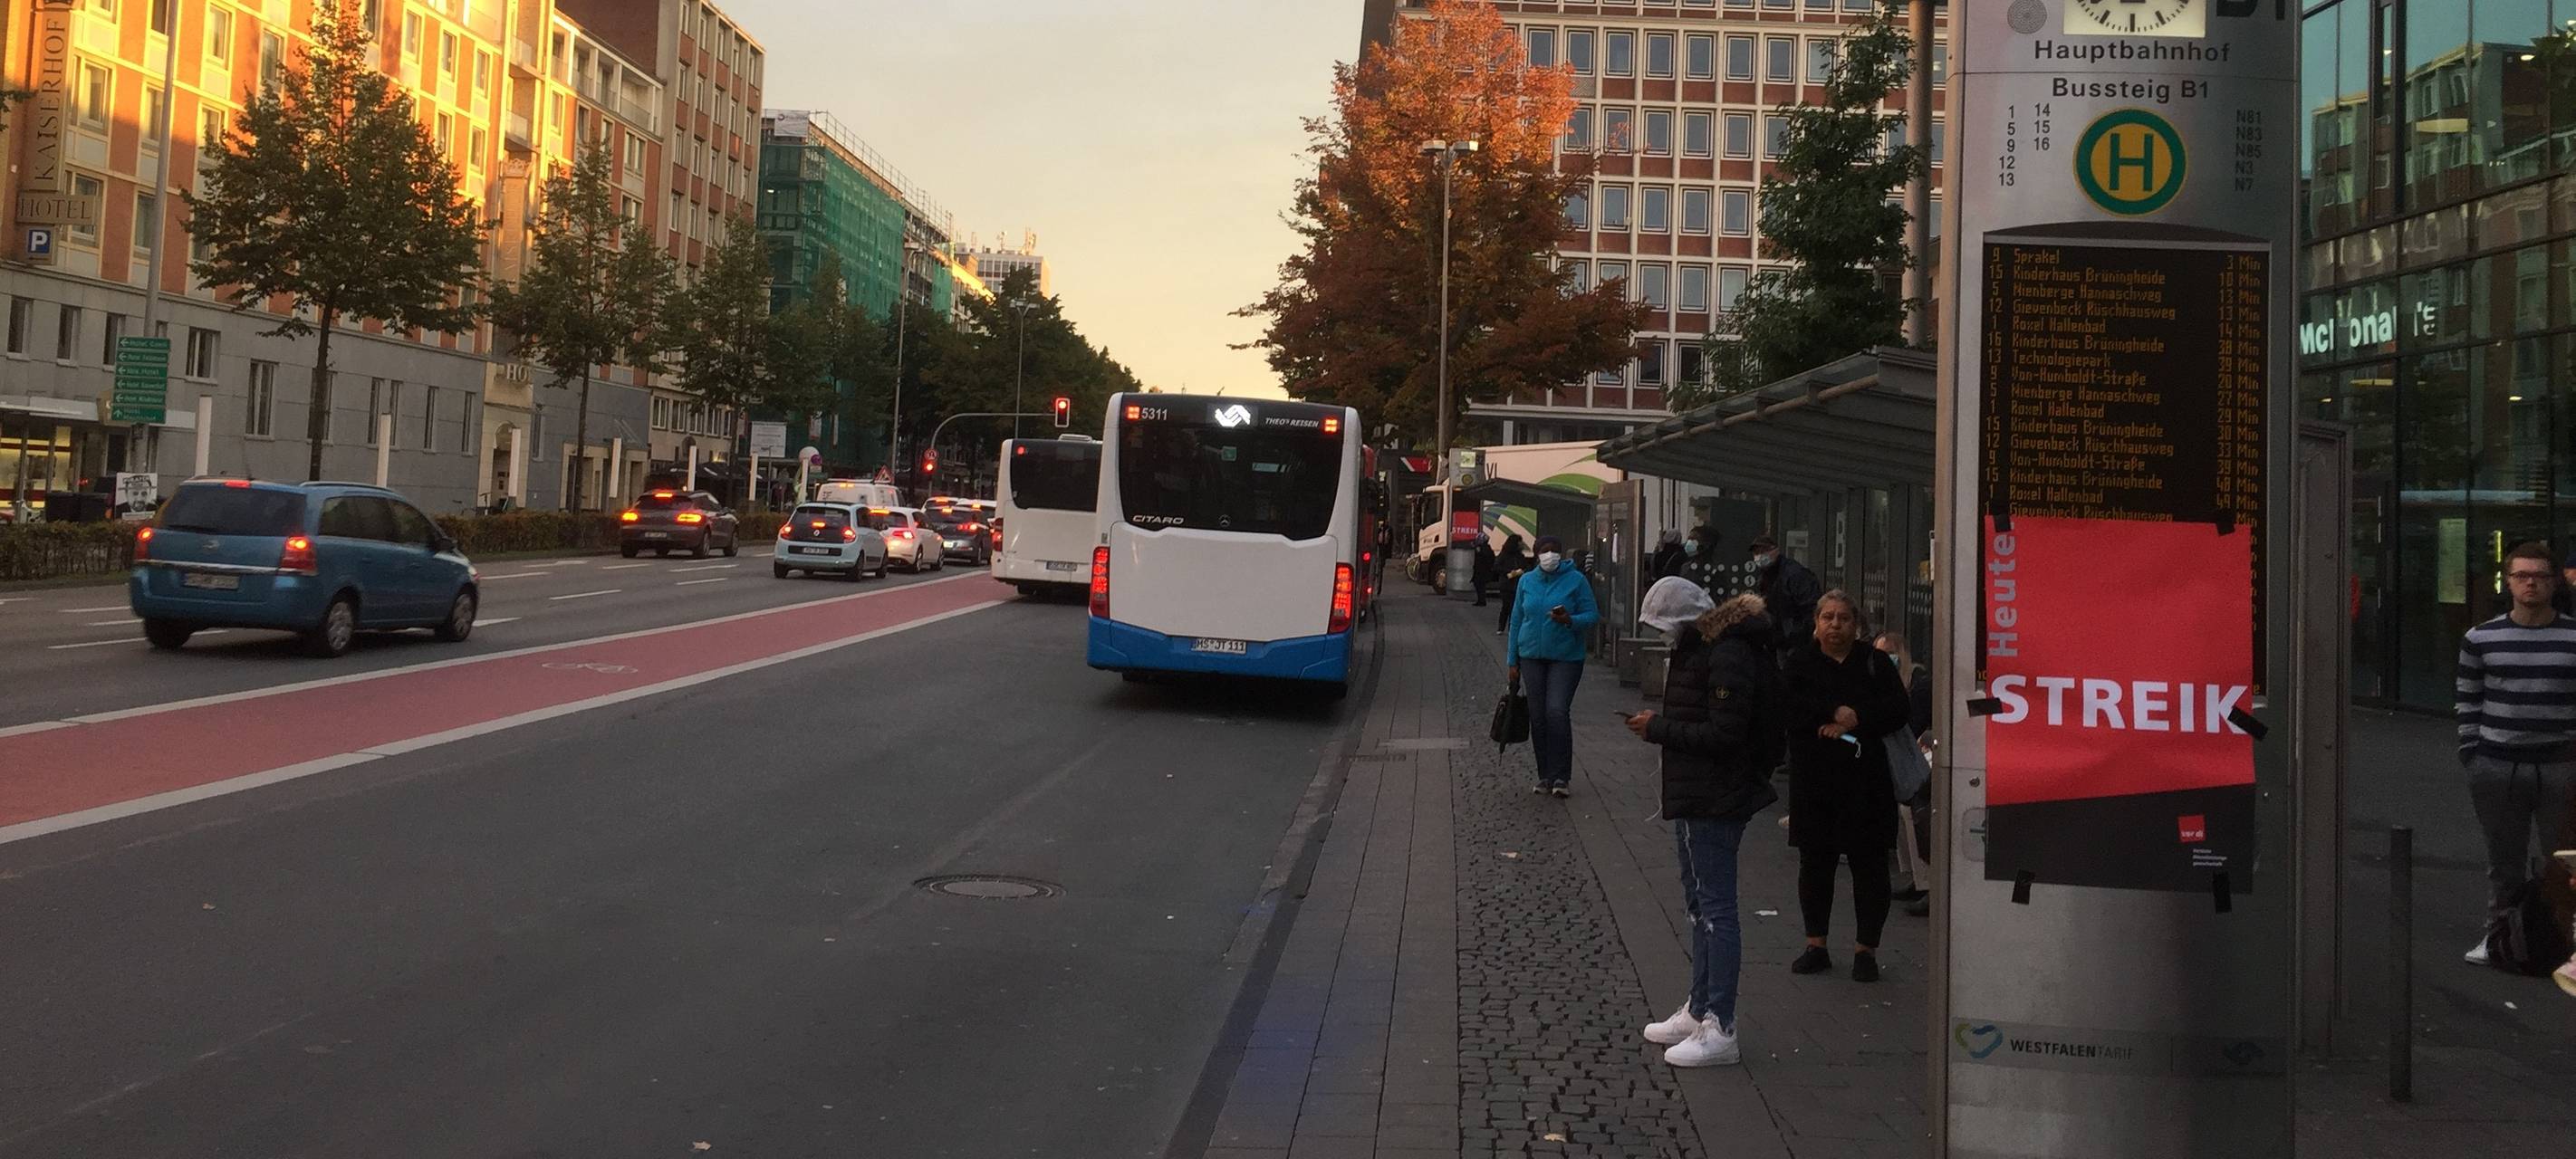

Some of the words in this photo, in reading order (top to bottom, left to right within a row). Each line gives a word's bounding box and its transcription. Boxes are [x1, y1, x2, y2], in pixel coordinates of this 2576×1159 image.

[2034, 40, 2231, 64] Hauptbahnhof
[34, 17, 66, 180] KAISERHOF
[2052, 77, 2170, 104] Bussteig
[2181, 81, 2208, 99] B1
[2008, 105, 2015, 119] 1
[2034, 103, 2051, 117] 14
[2236, 109, 2262, 124] N81
[2007, 122, 2015, 136] 5
[2034, 120, 2051, 134] 15
[2007, 139, 2015, 152] 9
[2034, 138, 2051, 151] 16
[2235, 143, 2262, 158] N85
[1999, 156, 2015, 169] 12
[2109, 133, 2154, 192] H
[2235, 160, 2254, 175] N3
[1999, 173, 2015, 187] 13
[2235, 177, 2254, 191] N7
[19, 198, 91, 220] HOTEL
[31, 232, 48, 252] P
[2014, 248, 2061, 264] Sprakel
[1989, 264, 2003, 279] 15
[2013, 265, 2081, 283] Kinderhaus
[2086, 267, 2166, 285] Brüningheide
[1992, 282, 1999, 296] 5
[2013, 283, 2074, 299] Nienberge
[2080, 284, 2162, 303] Hannaschweg
[1989, 298, 2003, 312] 12
[2013, 300, 2081, 316] Gievenbeck
[2087, 302, 2176, 320] Rüschhausweg
[2013, 316, 2044, 331] Roxel
[2049, 317, 2106, 333] Hallenbad
[1988, 331, 2002, 346] 16
[2012, 332, 2079, 350] Kinderhaus
[2084, 334, 2165, 352] Brüningheide
[2013, 350, 2110, 368] Technologiepark
[2237, 375, 2259, 389] Min
[1990, 383, 1997, 398] 5
[2011, 384, 2073, 401] Nienberge
[2078, 386, 2160, 405] Hannaschweg
[2237, 392, 2258, 407] Min
[1141, 407, 1168, 421] 5311
[2011, 400, 2043, 416] Roxel
[2048, 402, 2105, 418] Hallenbad
[2236, 409, 2258, 424] Min
[1290, 419, 1319, 428] REISEN
[1986, 417, 2000, 431] 15
[2010, 417, 2078, 434] Kinderhaus
[2083, 419, 2164, 437] Brüningheide
[2236, 426, 2258, 441] Min
[1986, 433, 2000, 447] 12
[2010, 434, 2080, 451] Gievenbeck
[2085, 436, 2174, 455] Rüschhausweg
[2237, 444, 2258, 458] Min
[2237, 461, 2258, 475] Min
[1985, 467, 1999, 482] 15
[2010, 468, 2077, 485] Kinderhaus
[2082, 470, 2163, 489] Brüningheide
[2236, 478, 2258, 493] Min
[2009, 485, 2042, 501] Roxel
[2046, 487, 2103, 503] Hallenbad
[2236, 495, 2258, 510] Min
[1132, 515, 1184, 525] CITARO
[1988, 522, 2019, 657] Heute
[1992, 674, 2248, 735] STREIK
[2010, 1039, 2136, 1060] WESTFALENTARIF
